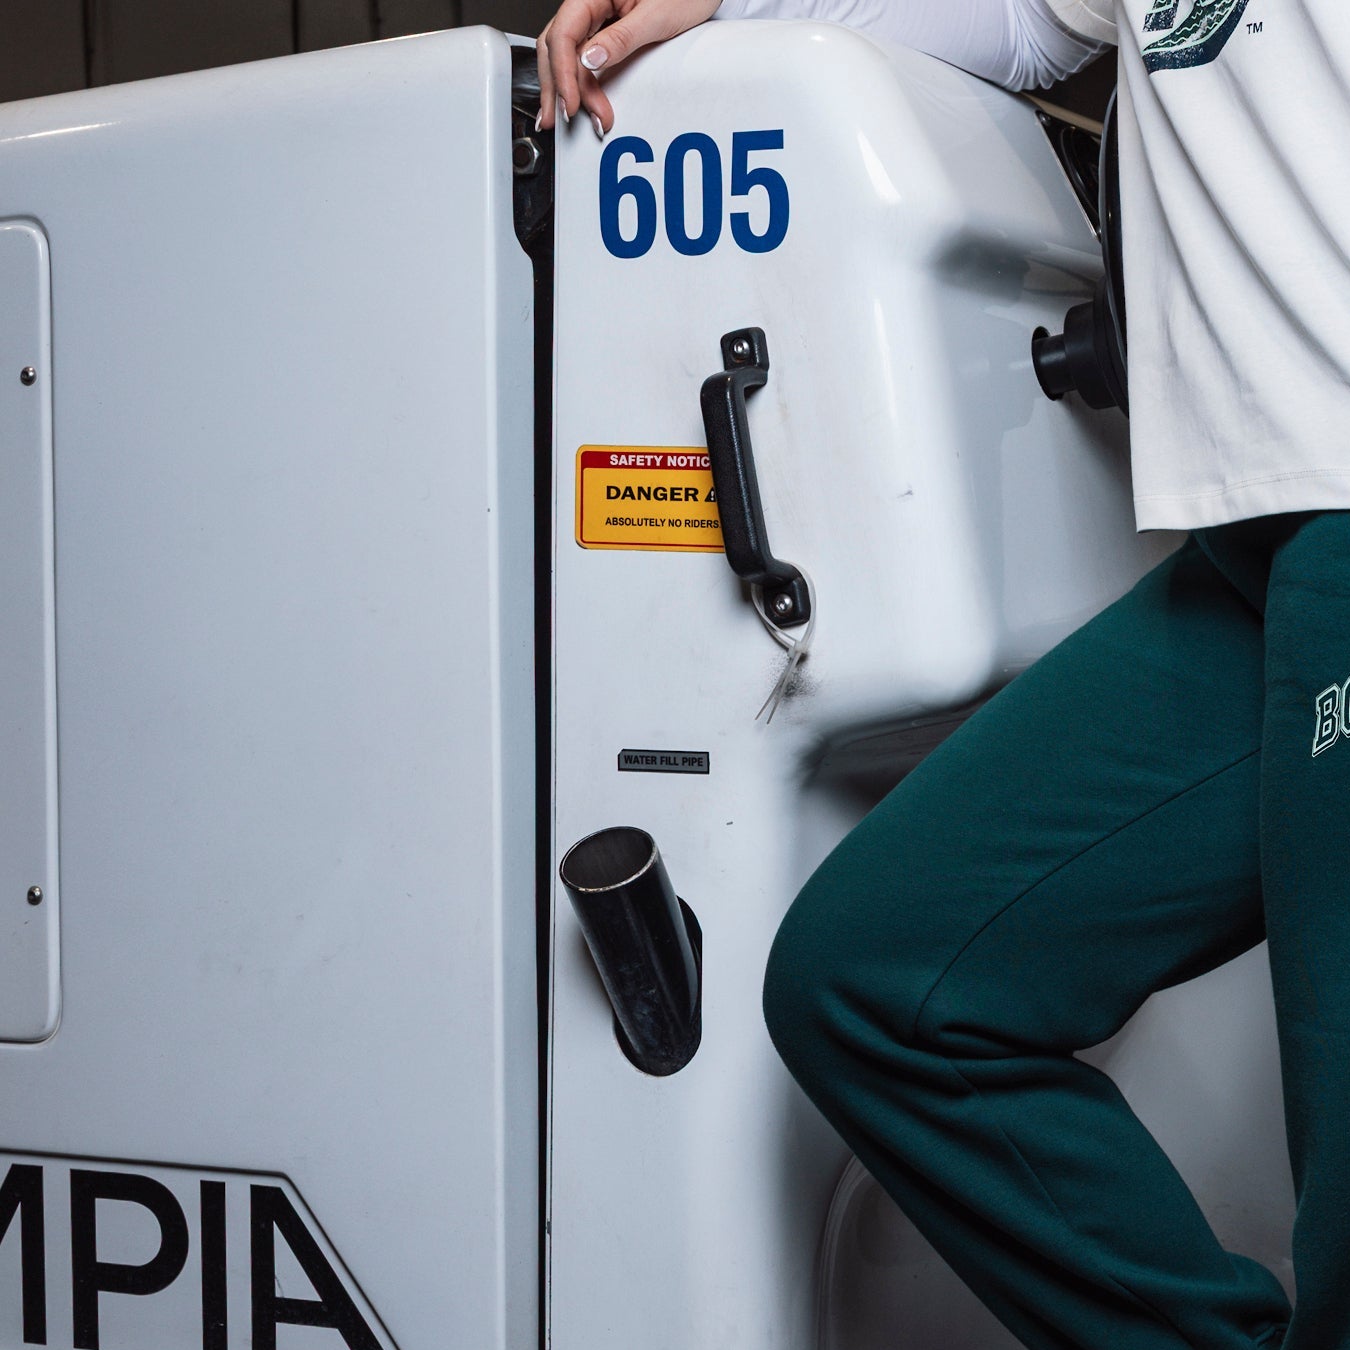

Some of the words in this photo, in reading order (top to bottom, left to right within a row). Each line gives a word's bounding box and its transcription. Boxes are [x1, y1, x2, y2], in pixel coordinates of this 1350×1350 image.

[600, 128, 790, 259] 605
[609, 453, 664, 467] SAFETY
[667, 455, 712, 468] NOTIC
[606, 485, 699, 502] DANGER
[605, 516, 666, 528] ABSOLUTELY
[668, 518, 682, 528] NO
[623, 754, 657, 766] WATER
[660, 755, 679, 767] FILL
[682, 756, 704, 767] PIPE
